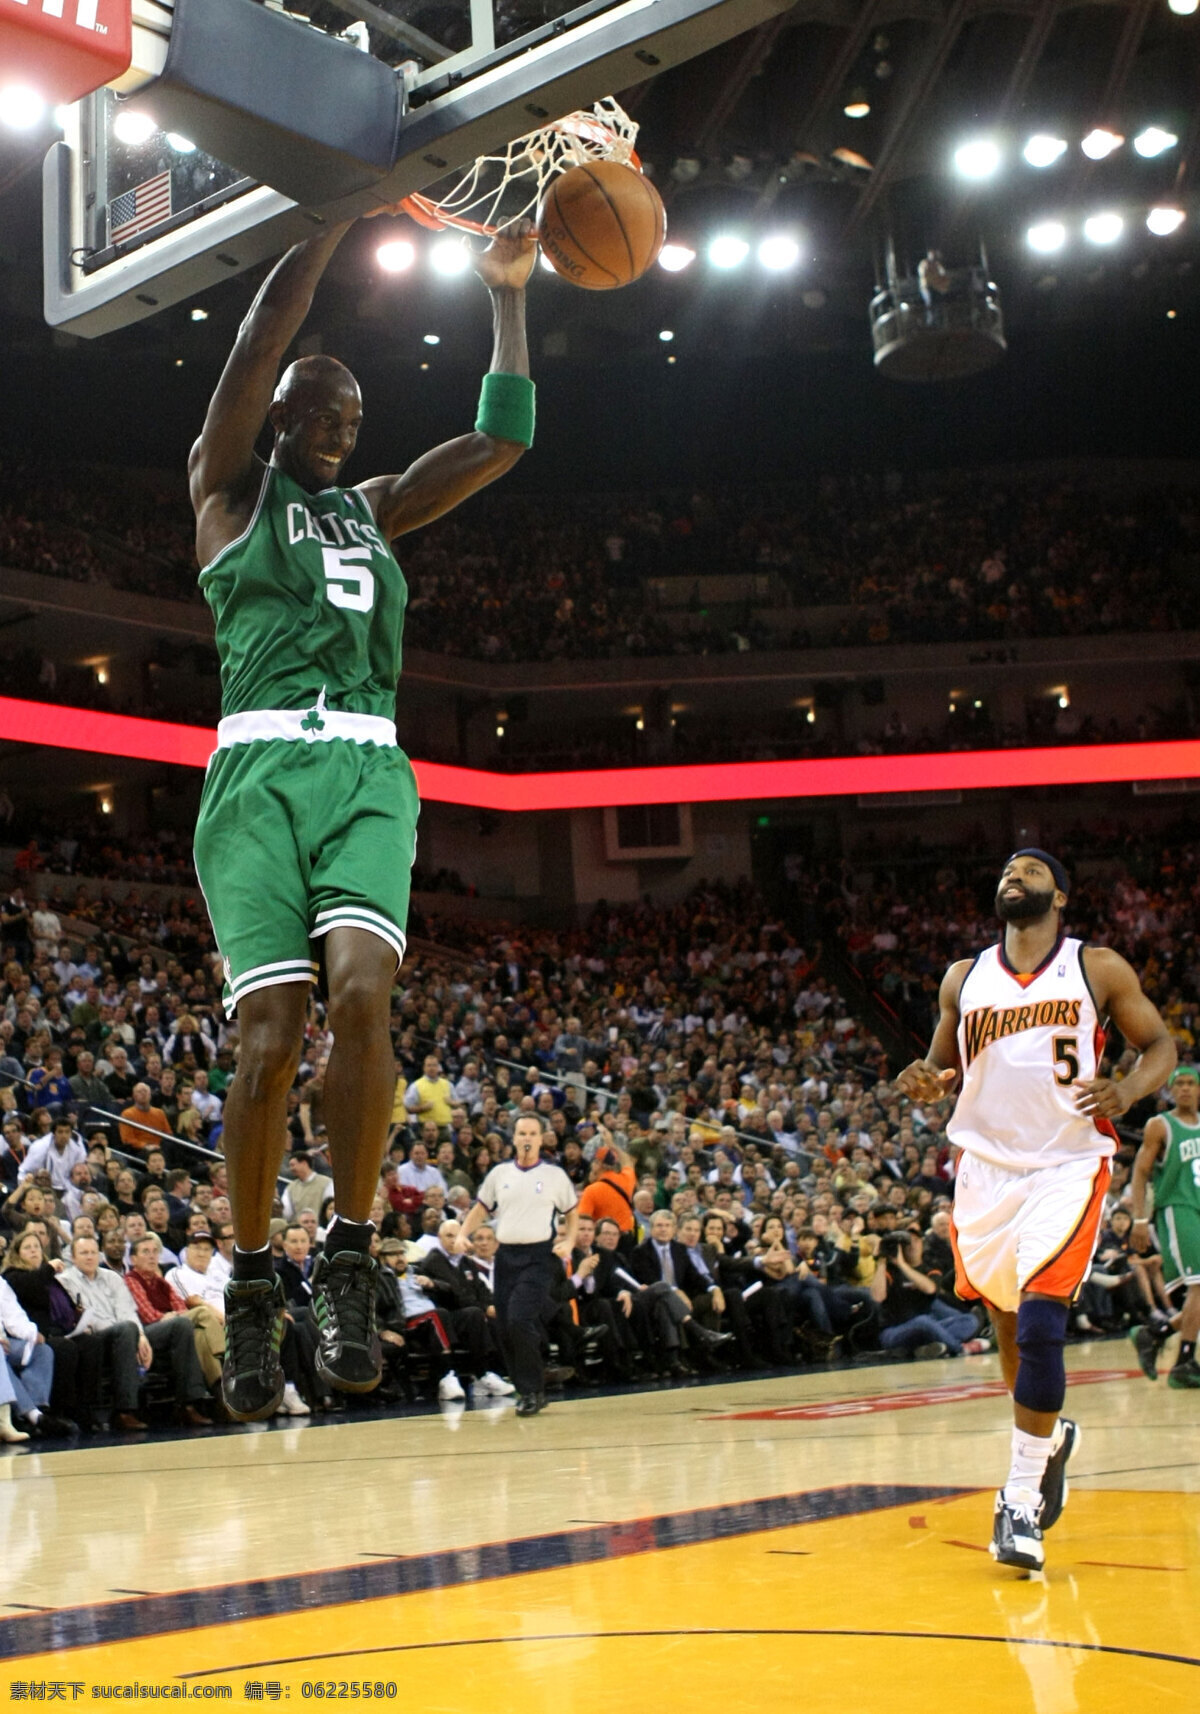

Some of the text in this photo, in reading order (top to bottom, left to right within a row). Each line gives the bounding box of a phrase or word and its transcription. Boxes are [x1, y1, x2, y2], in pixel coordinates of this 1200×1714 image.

[95, 22, 108, 35] TM
[287, 502, 389, 559] CELTCS
[321, 547, 375, 613] 5
[965, 999, 1081, 1070] WARRIORS
[1052, 1035, 1079, 1087] 5
